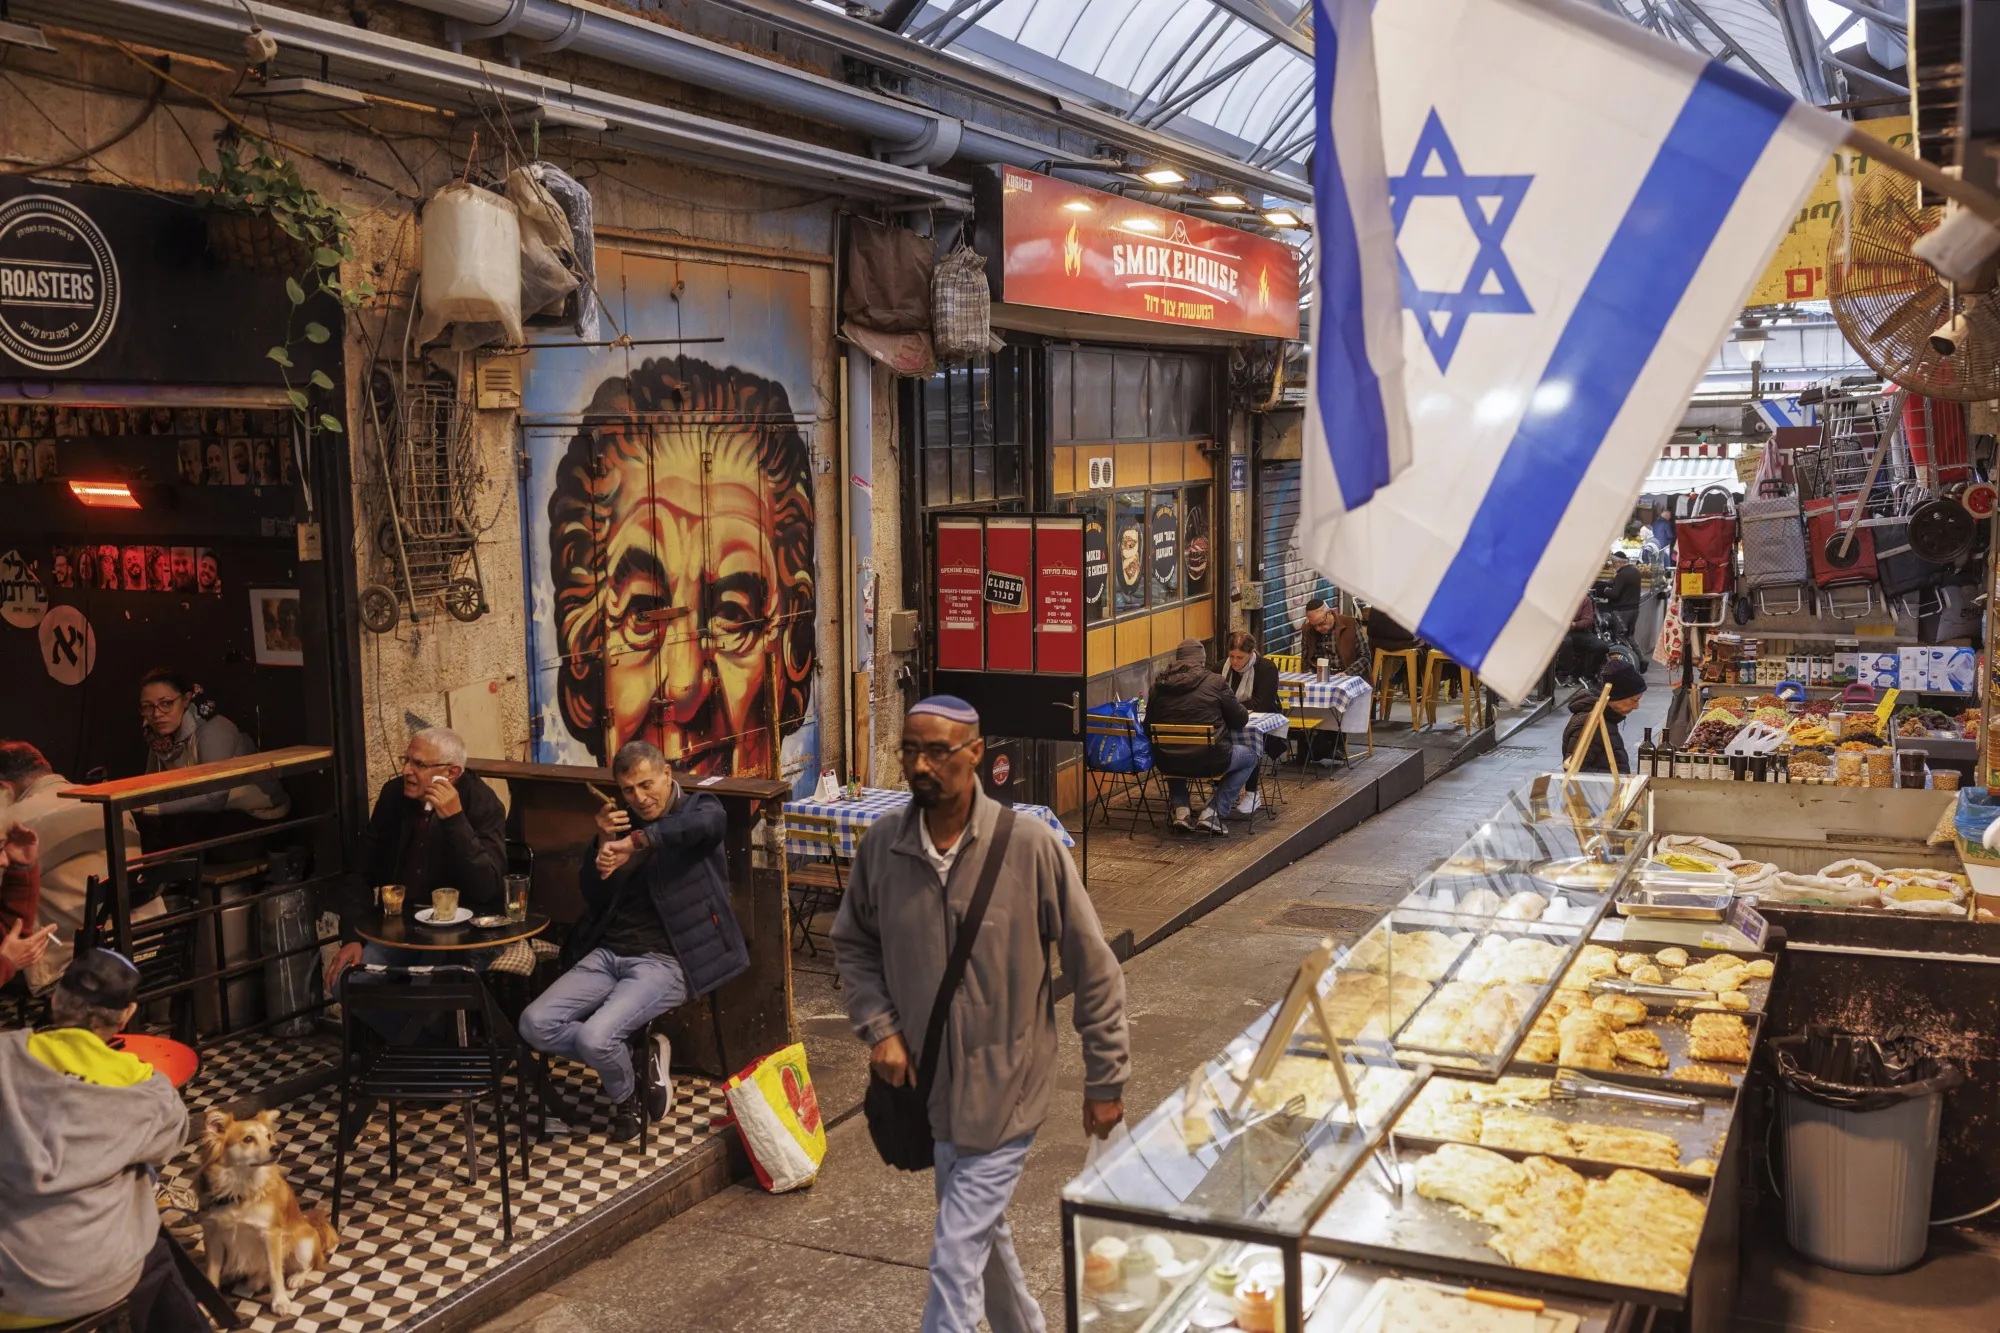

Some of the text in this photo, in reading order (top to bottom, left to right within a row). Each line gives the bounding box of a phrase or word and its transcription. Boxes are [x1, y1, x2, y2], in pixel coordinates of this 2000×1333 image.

[1006, 173, 1032, 192] KOSHER
[1113, 244, 1238, 296] SMOKEHOUSE
[1, 268, 94, 300] ROASTERS
[1086, 550, 1101, 562] MOKED
[964, 567, 980, 575] HOURS
[988, 578, 1022, 592] CLOSED
[993, 589, 1014, 601] סגור
